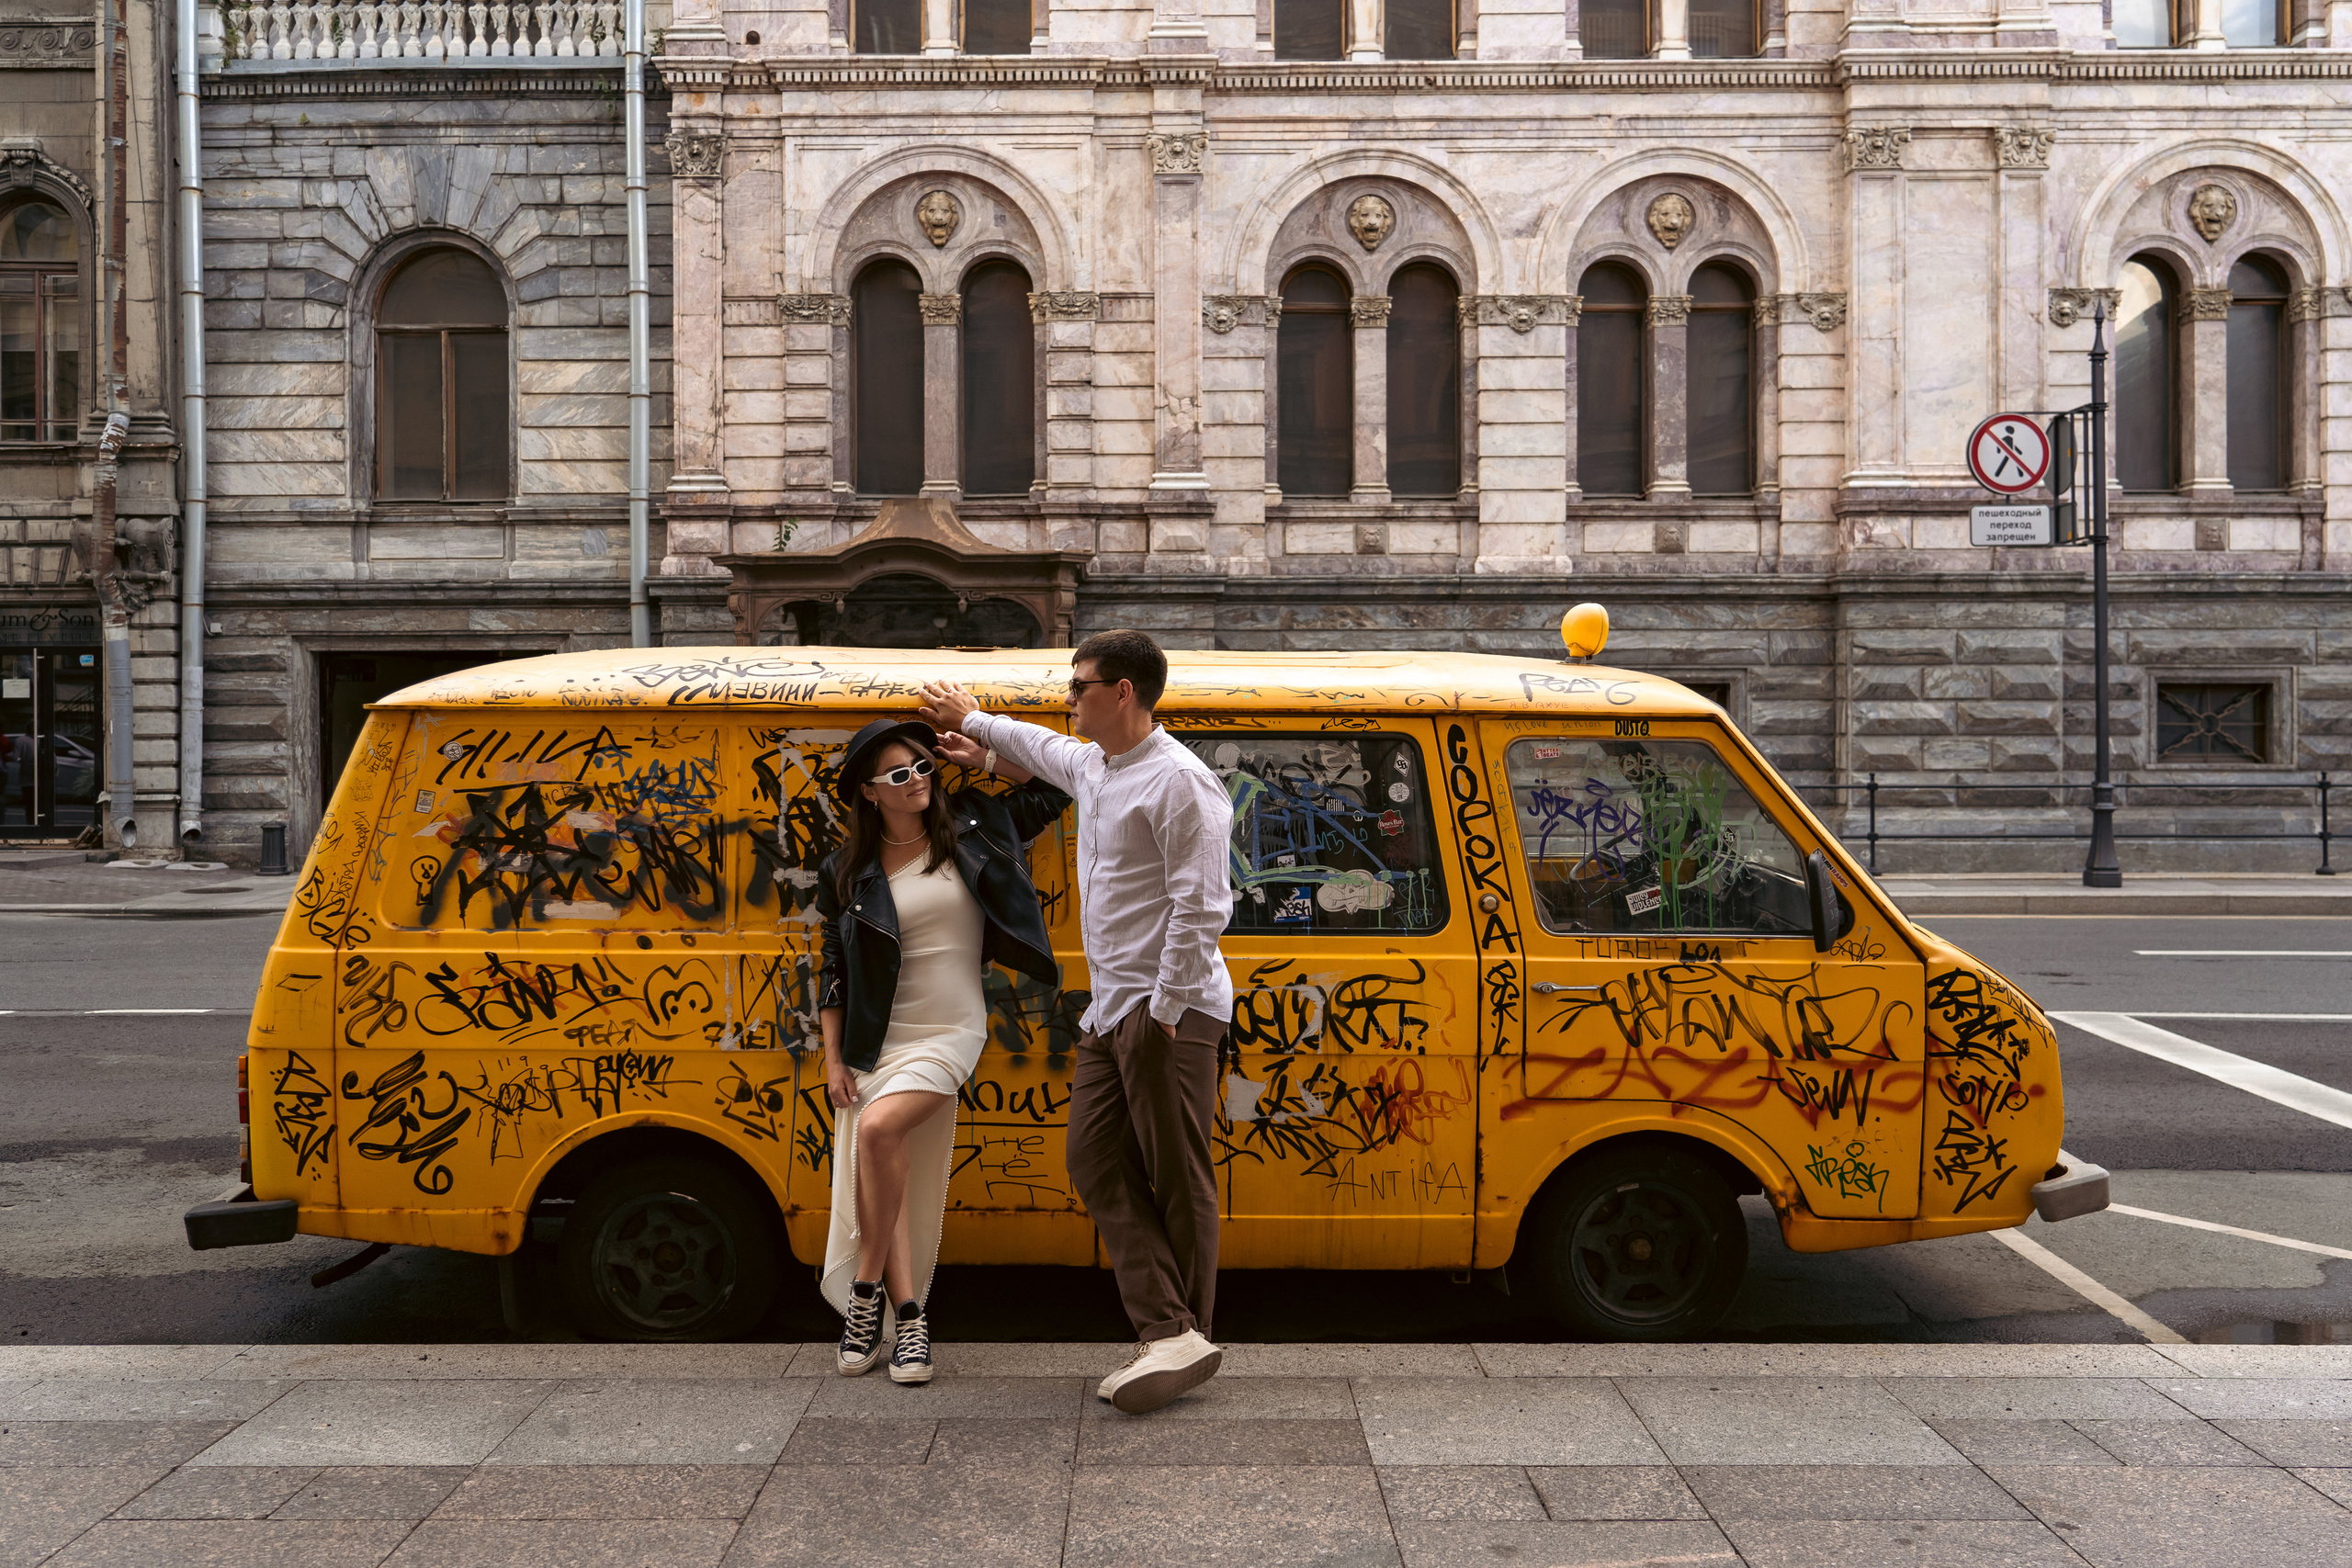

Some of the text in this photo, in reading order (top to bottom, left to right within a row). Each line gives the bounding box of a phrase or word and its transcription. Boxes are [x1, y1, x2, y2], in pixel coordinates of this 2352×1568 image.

[1978, 508, 2041, 517] пешеходный
[1989, 521, 2032, 531] переход
[1985, 533, 2036, 543] запрещен
[58, 608, 96, 626] Son
